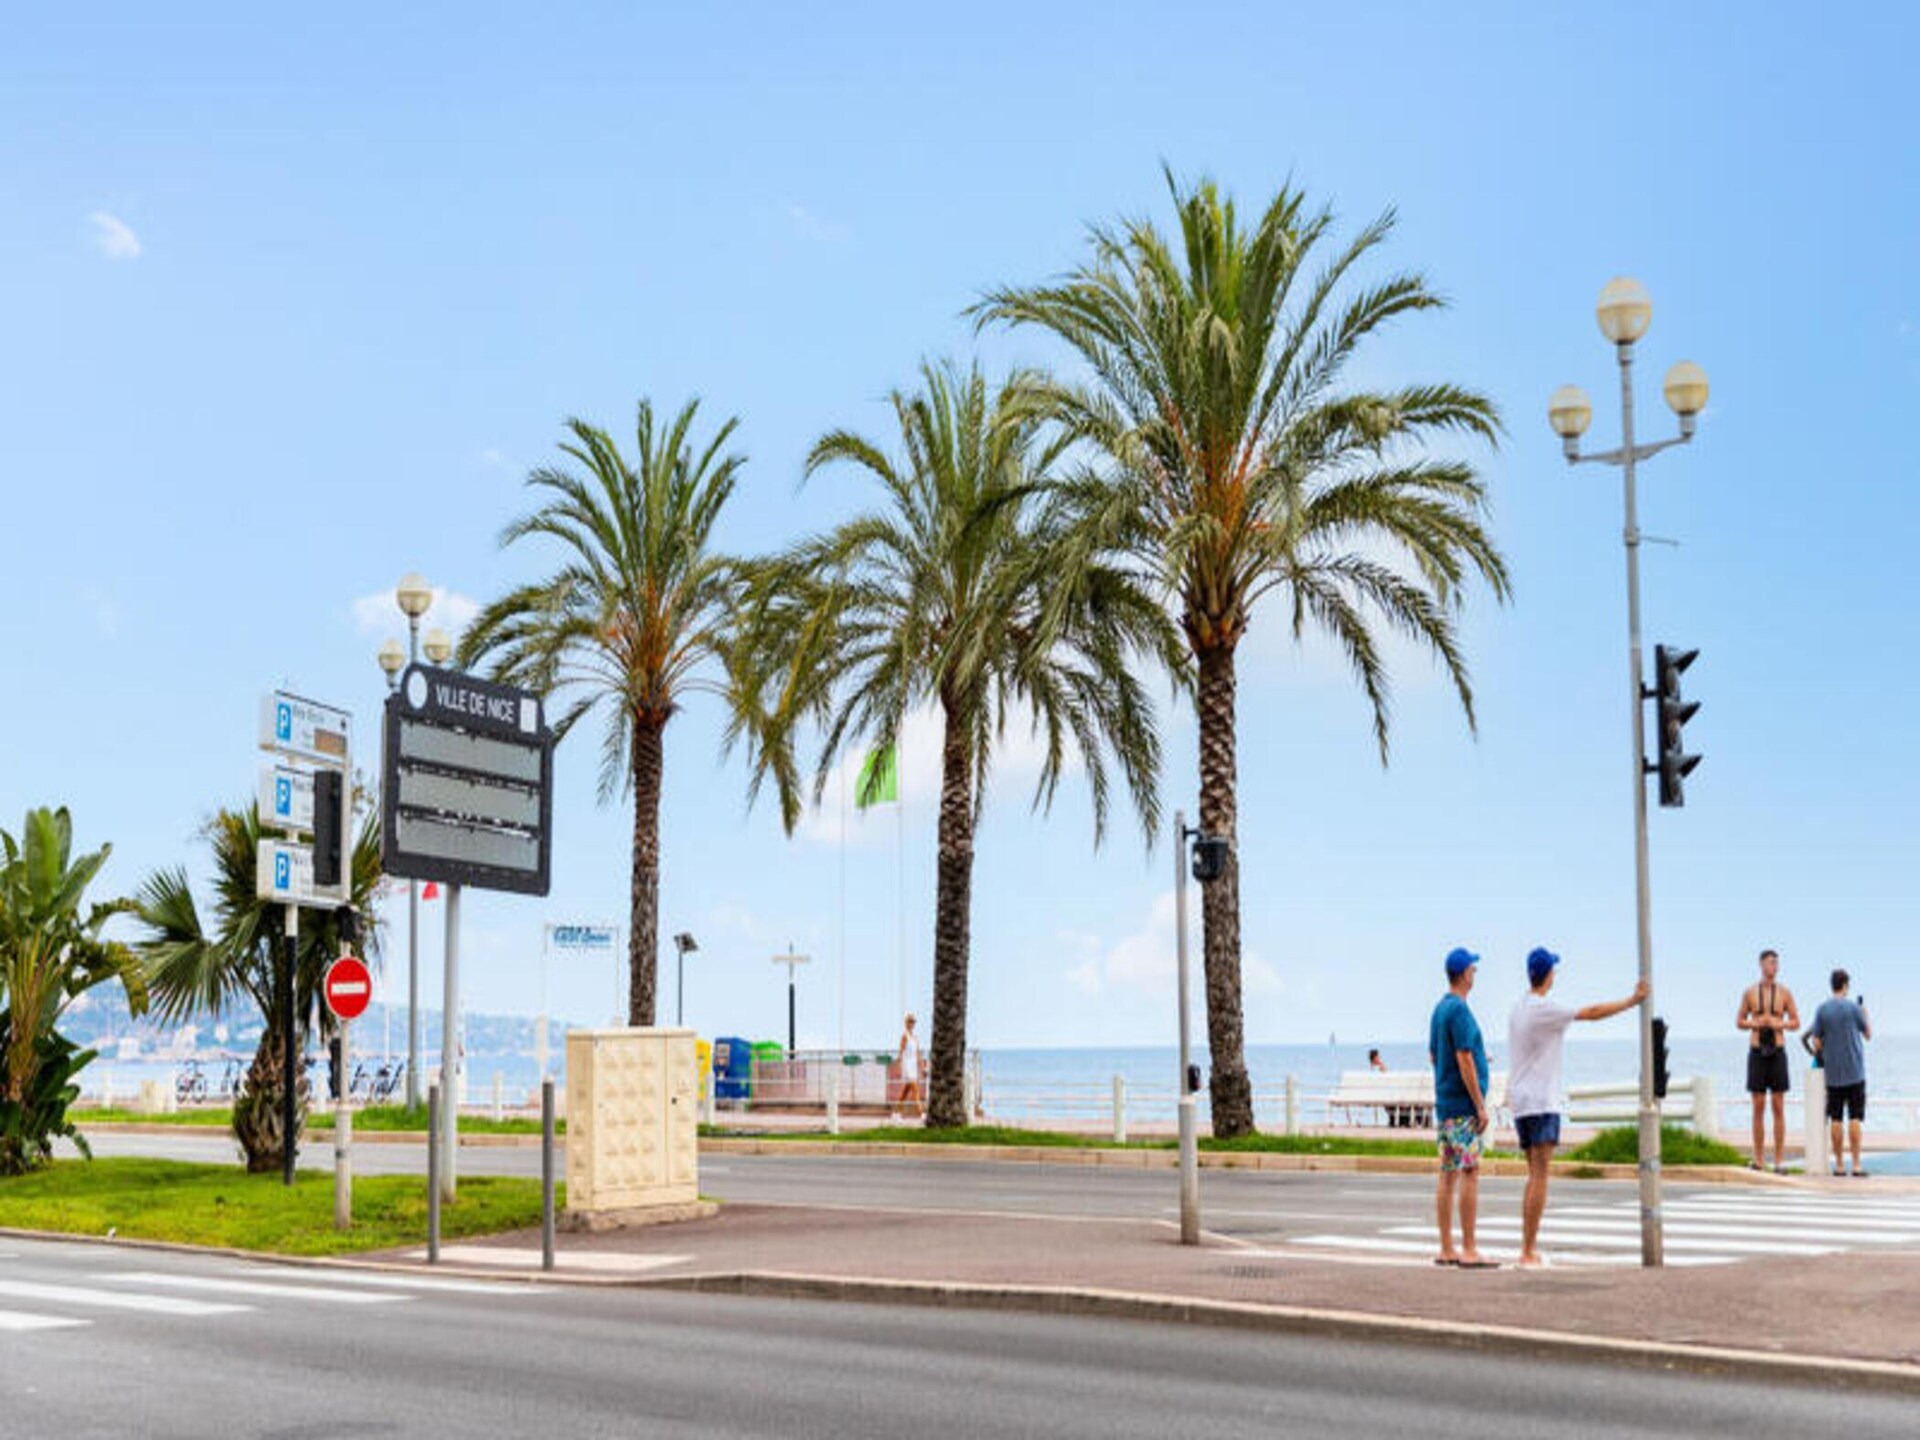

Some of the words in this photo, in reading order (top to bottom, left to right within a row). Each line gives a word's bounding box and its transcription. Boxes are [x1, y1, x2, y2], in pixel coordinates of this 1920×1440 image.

[436, 683, 467, 713] VILLE
[469, 691, 486, 717] DE
[487, 697, 515, 724] NICE
